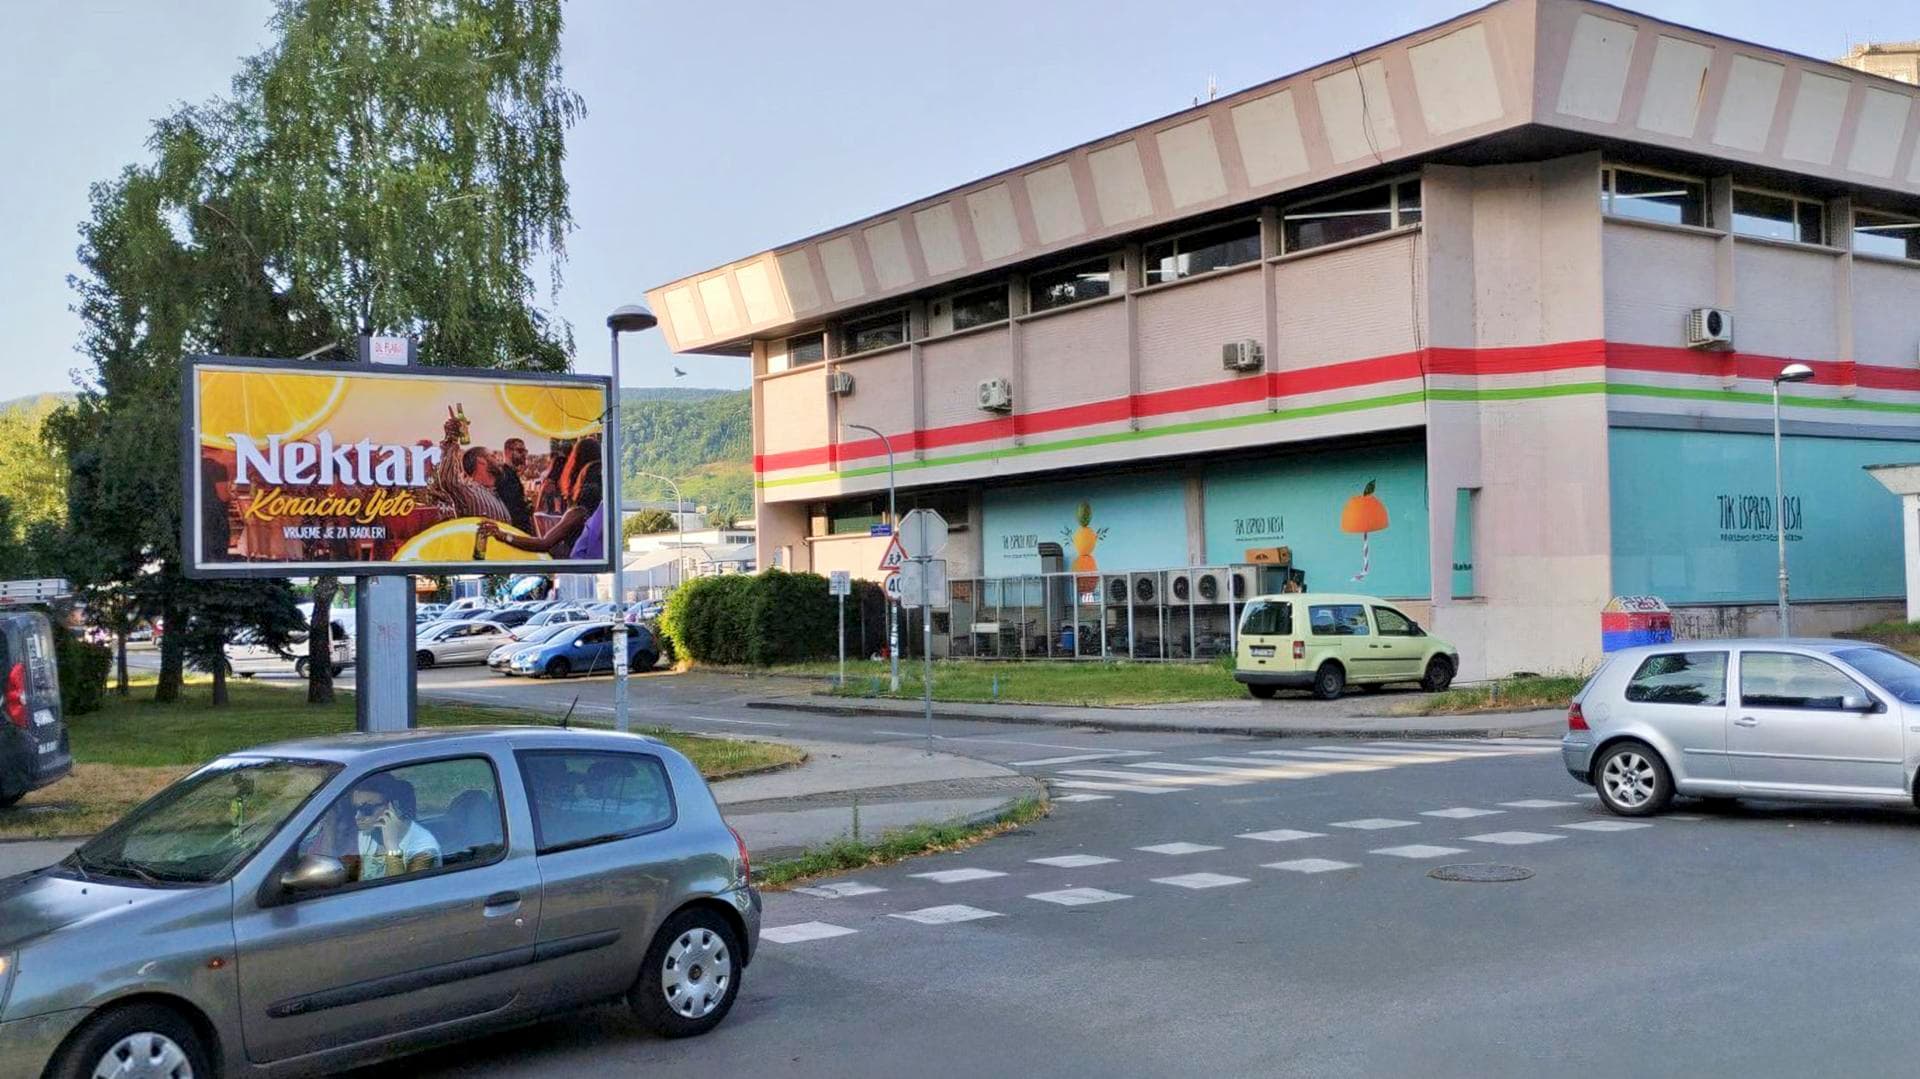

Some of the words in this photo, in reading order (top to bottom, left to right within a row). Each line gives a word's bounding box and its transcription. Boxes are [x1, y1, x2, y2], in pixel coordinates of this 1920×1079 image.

[226, 430, 442, 487] Nektar
[244, 487, 361, 521] Konačno
[356, 487, 416, 524] ljeto
[282, 526, 320, 539] VRIJEME
[323, 526, 335, 539] JE
[337, 527, 348, 539] ZA
[349, 526, 386, 539] RADLER!
